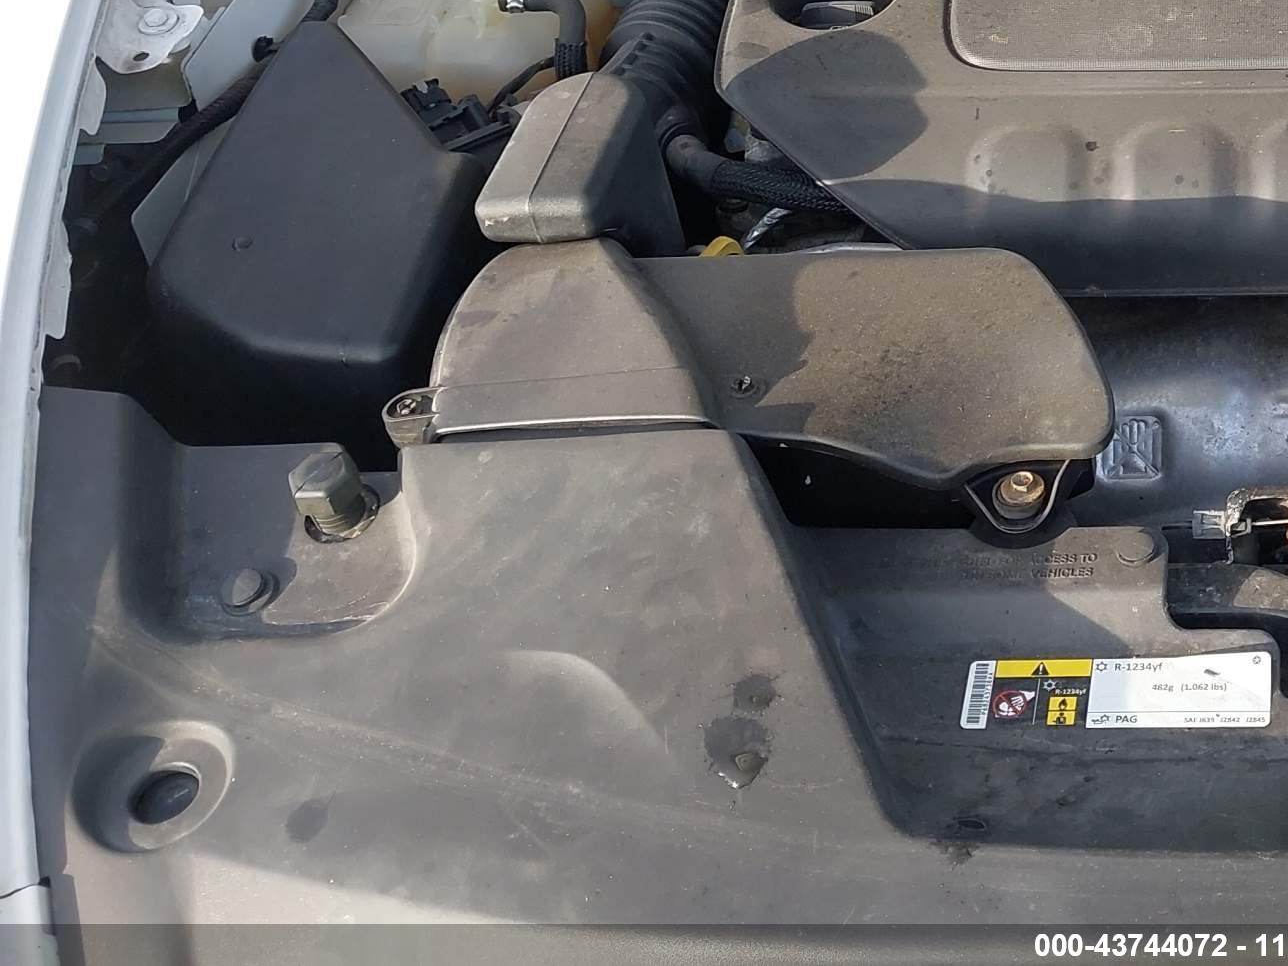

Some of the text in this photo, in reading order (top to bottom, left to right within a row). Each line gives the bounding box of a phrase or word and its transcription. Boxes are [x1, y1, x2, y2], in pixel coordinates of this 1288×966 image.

[1031, 553, 1077, 566] ACCESS
[1080, 552, 1098, 564] TO
[1031, 567, 1095, 579] VEHICLES
[1114, 662, 1163, 672] R-1234yf
[1055, 688, 1088, 696] R-1234yf
[1115, 714, 1138, 723] PAG
